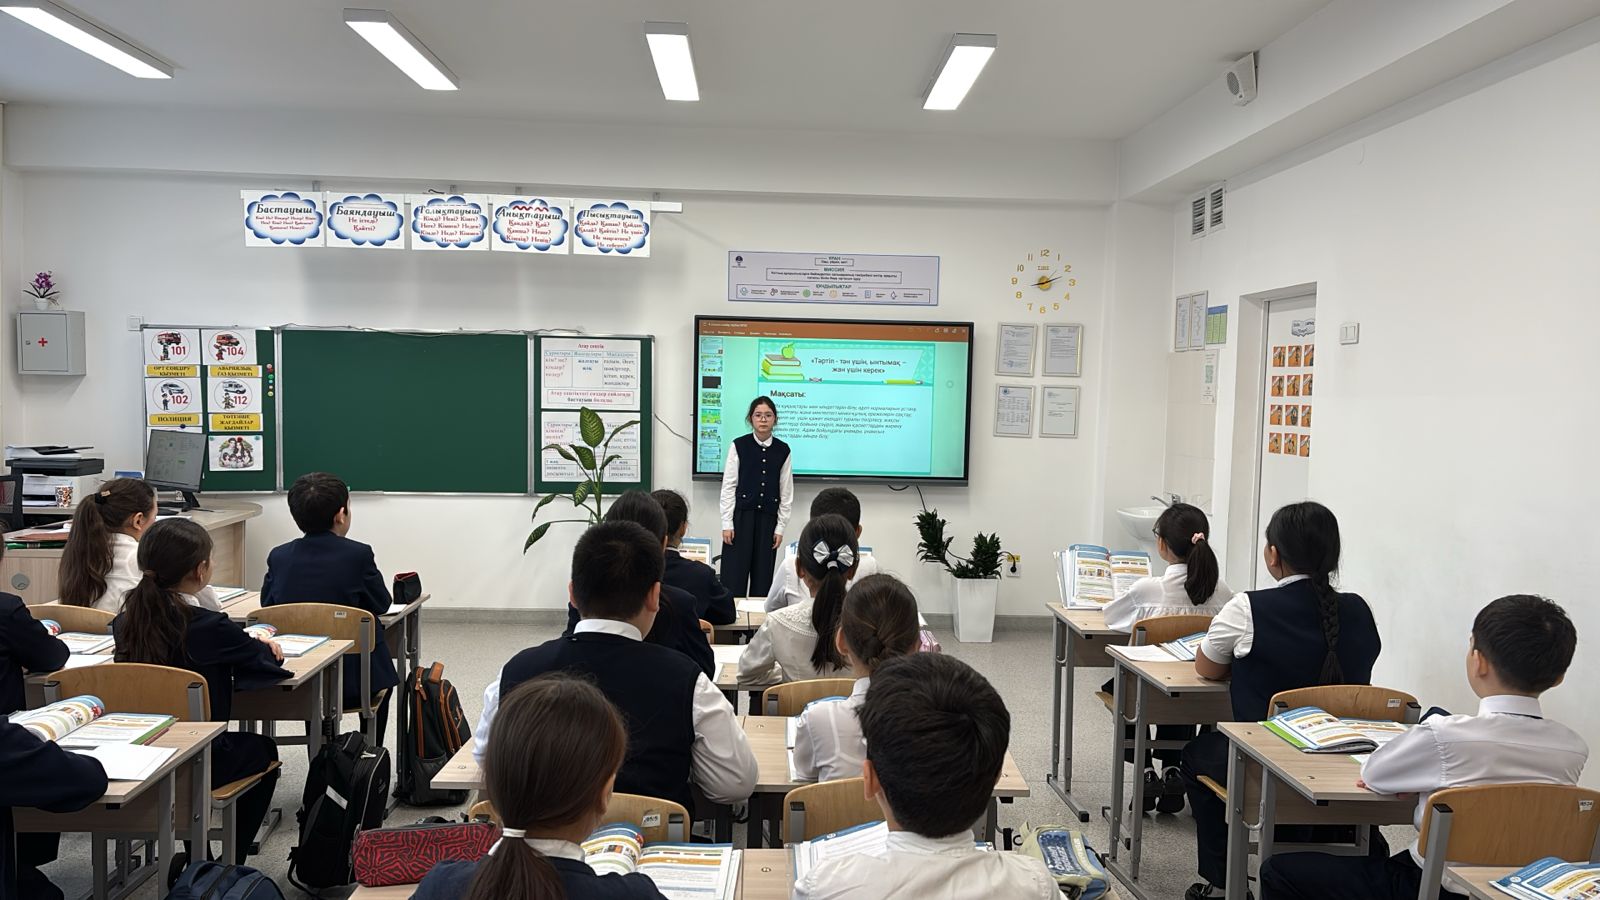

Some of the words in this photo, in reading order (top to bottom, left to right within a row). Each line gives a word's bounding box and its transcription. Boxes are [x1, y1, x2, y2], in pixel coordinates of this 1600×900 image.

[256, 203, 313, 215] Бастауыш
[336, 205, 395, 218] Баяндауыш
[418, 205, 480, 216] Толықтауыш
[498, 208, 561, 220] Анықтауыш
[582, 210, 639, 220] Пысықтауыш
[1027, 253, 1033, 261] 11
[1040, 249, 1050, 257] 12
[1017, 264, 1024, 272] 10
[171, 346, 186, 355] 101
[227, 347, 243, 355] 104
[811, 357, 834, 365] «Тәртіп
[770, 390, 806, 398] Мақсаты:
[171, 395, 188, 404] 102
[233, 396, 247, 404] 112
